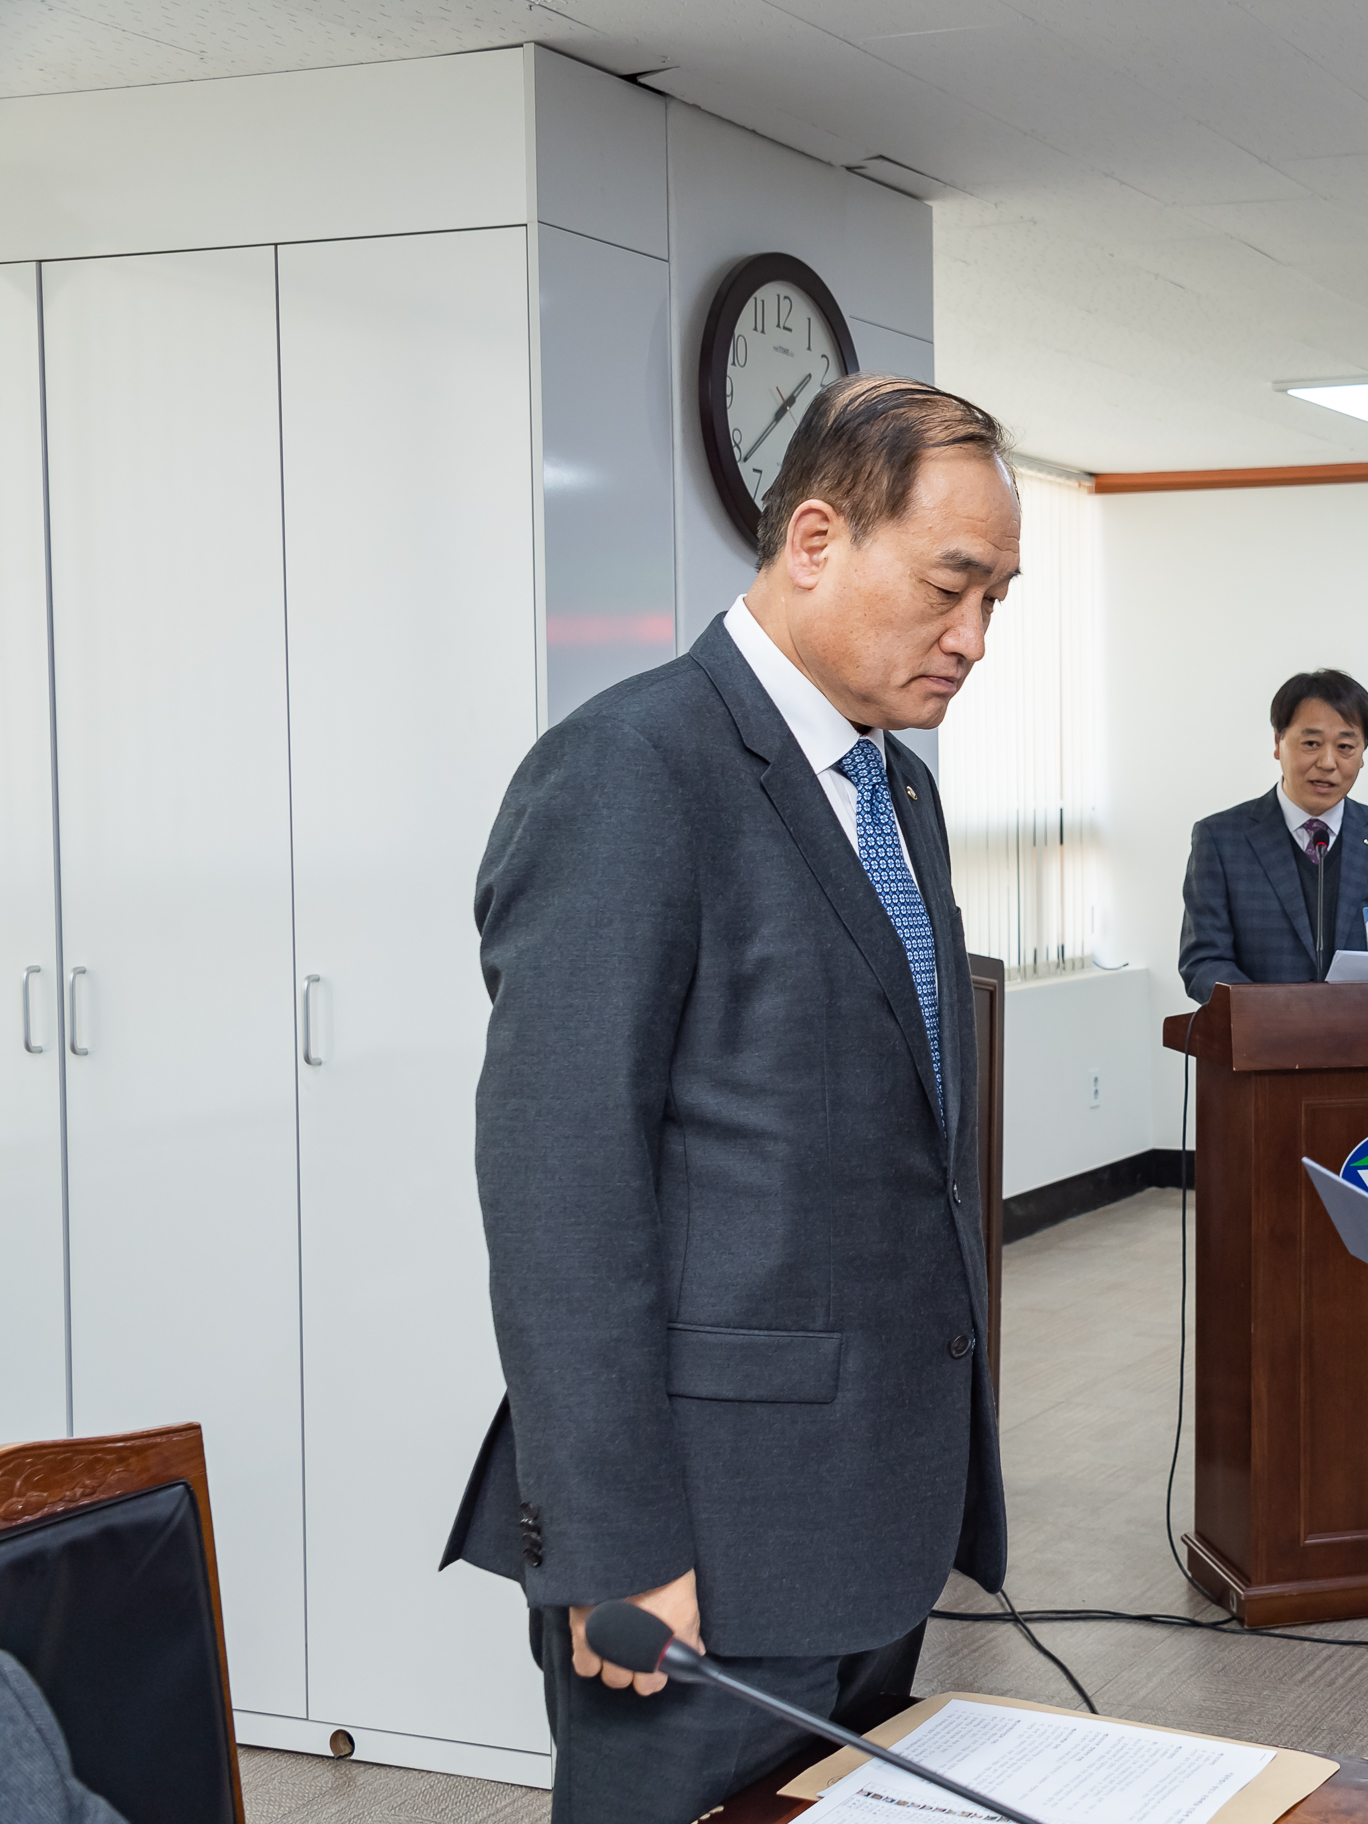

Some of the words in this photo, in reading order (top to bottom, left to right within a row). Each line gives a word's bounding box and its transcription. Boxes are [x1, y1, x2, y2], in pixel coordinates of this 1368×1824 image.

[752, 296, 766, 335] 11
[775, 293, 793, 333] 12
[730, 331, 748, 368] 10
[806, 317, 812, 352] 1
[820, 353, 831, 387] 2
[731, 427, 742, 463] 8
[752, 467, 762, 500] 7
